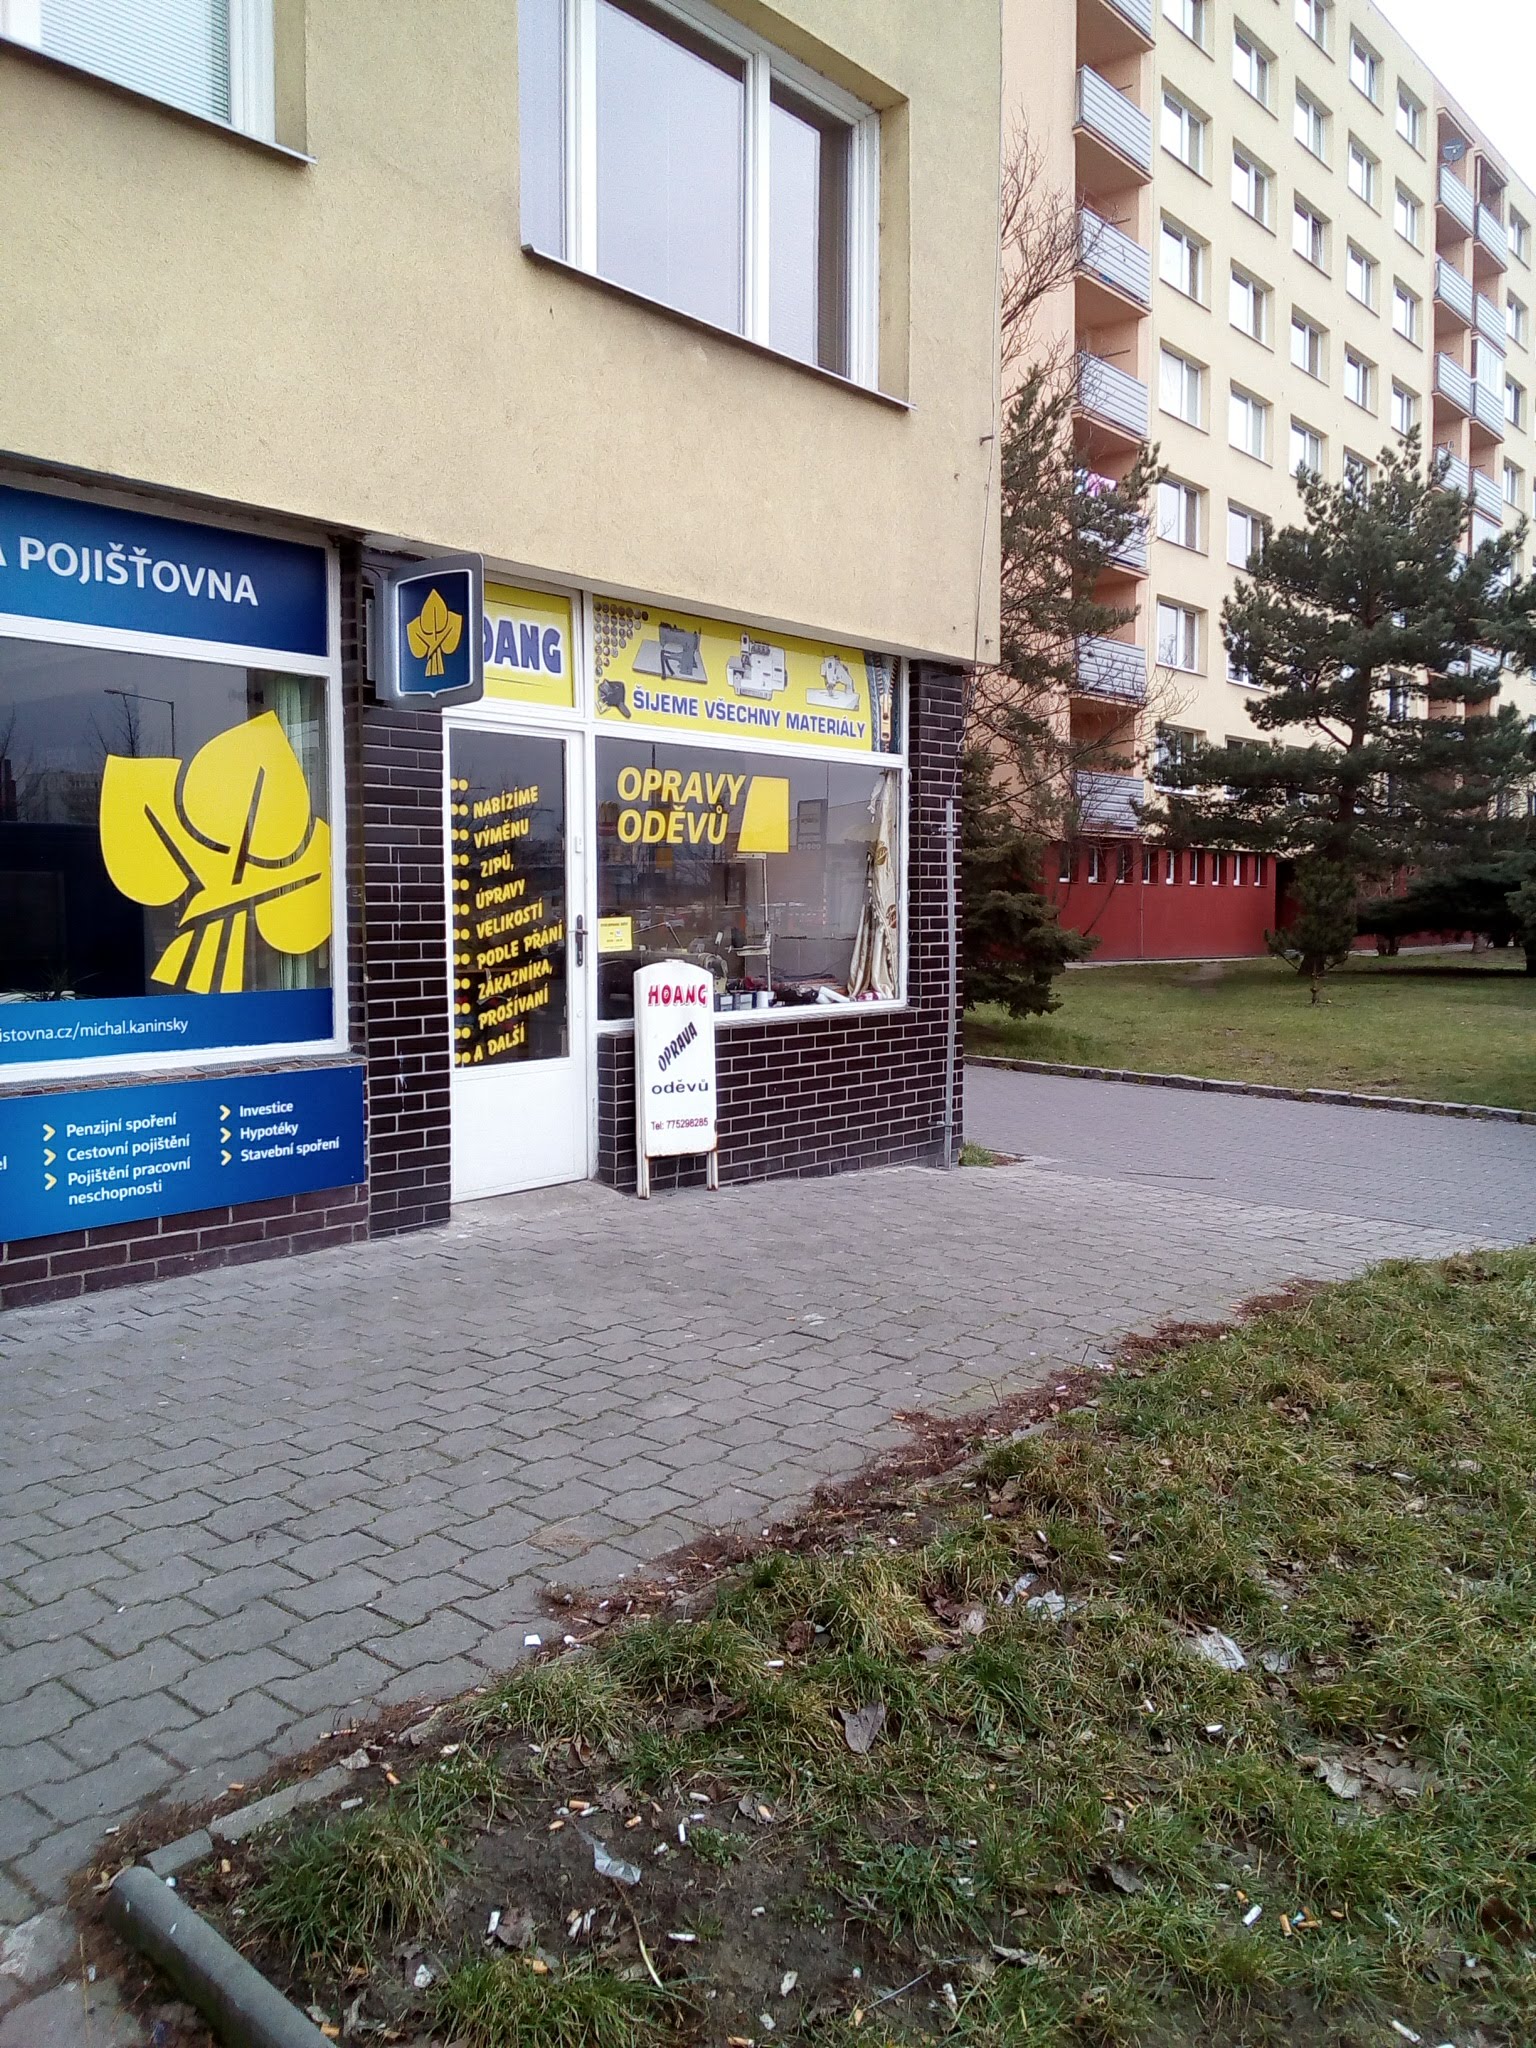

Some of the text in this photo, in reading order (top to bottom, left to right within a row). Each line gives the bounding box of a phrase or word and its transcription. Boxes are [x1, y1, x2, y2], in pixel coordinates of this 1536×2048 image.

[19, 536, 258, 606] POJIŠŤOVNA
[633, 688, 866, 739] ŠIJEME VŠECHNY MATERIÁLY
[473, 785, 539, 819] NABÍZÍME
[617, 766, 747, 806] OPRAVY
[474, 818, 530, 849] VÝMĚNU
[617, 805, 730, 845] ODĚVŮ
[476, 878, 526, 910] ÚPRAVY
[476, 898, 544, 940] VELIKOSTÍ
[477, 919, 563, 970] PODLE PŘÁNÍ
[478, 958, 553, 1000] ZÁKAZNÍKA,
[648, 984, 708, 1007] HOANG
[474, 1022, 525, 1063] A DALŠÍ
[658, 1021, 698, 1073] OPRAVA
[651, 1078, 709, 1095] oděvů
[66, 1112, 177, 1138] Penzijní spoření
[239, 1100, 294, 1118] Investice
[67, 1134, 190, 1162] Cestovní pojištění
[240, 1122, 299, 1142] Hypotéky
[240, 1137, 340, 1162] Stavební spoření
[68, 1156, 191, 1188] Pojištění pracovní
[68, 1179, 163, 1206] neschopnosti
